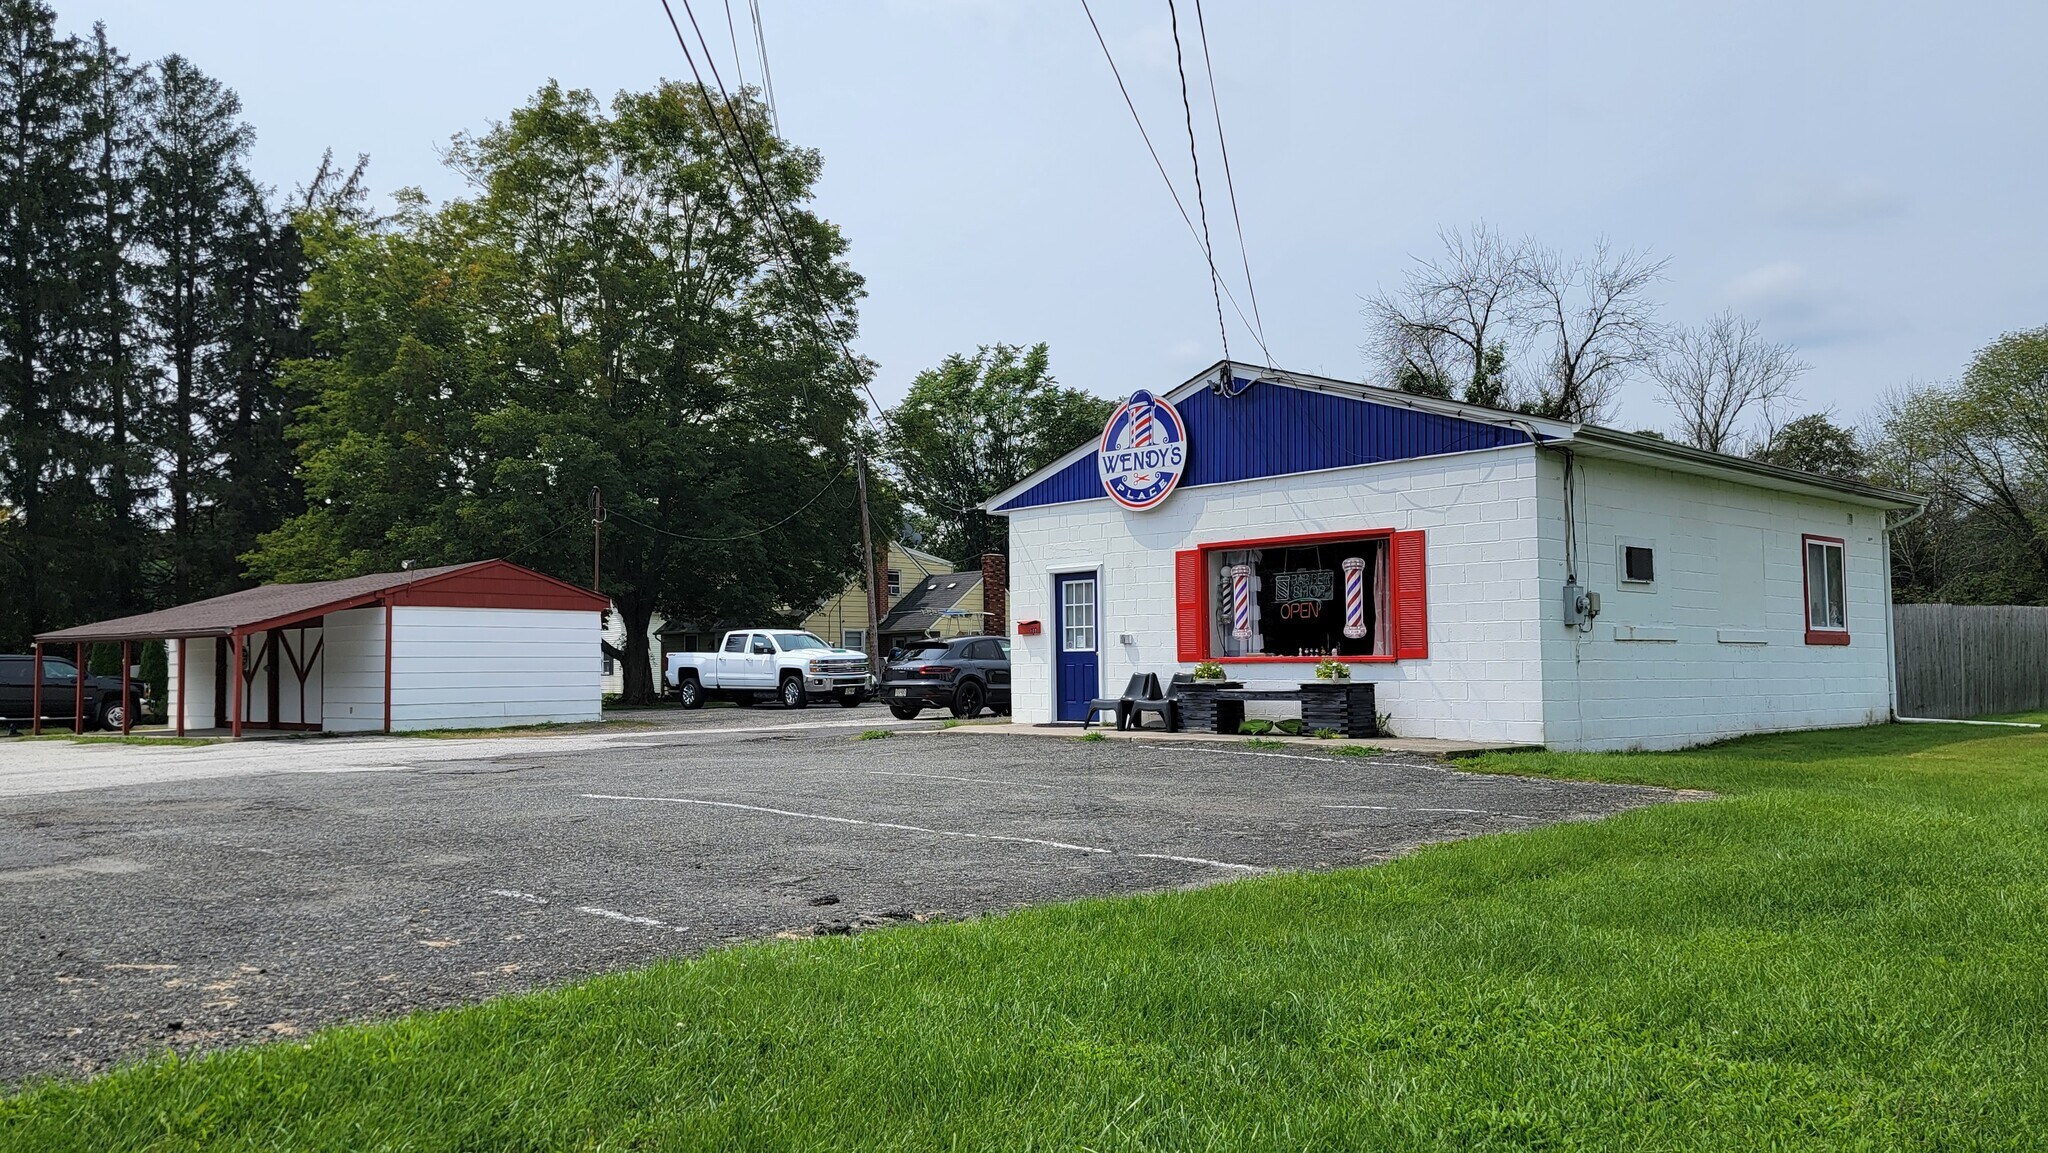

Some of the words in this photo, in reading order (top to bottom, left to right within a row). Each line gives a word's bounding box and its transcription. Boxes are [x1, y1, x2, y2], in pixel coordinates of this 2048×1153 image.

[1103, 445, 1182, 474] WENDY'S
[1117, 480, 1168, 500] PLACE
[1291, 573, 1330, 586] BARBER
[1293, 585, 1326, 598] SHOP
[1281, 602, 1318, 619] OPEN
